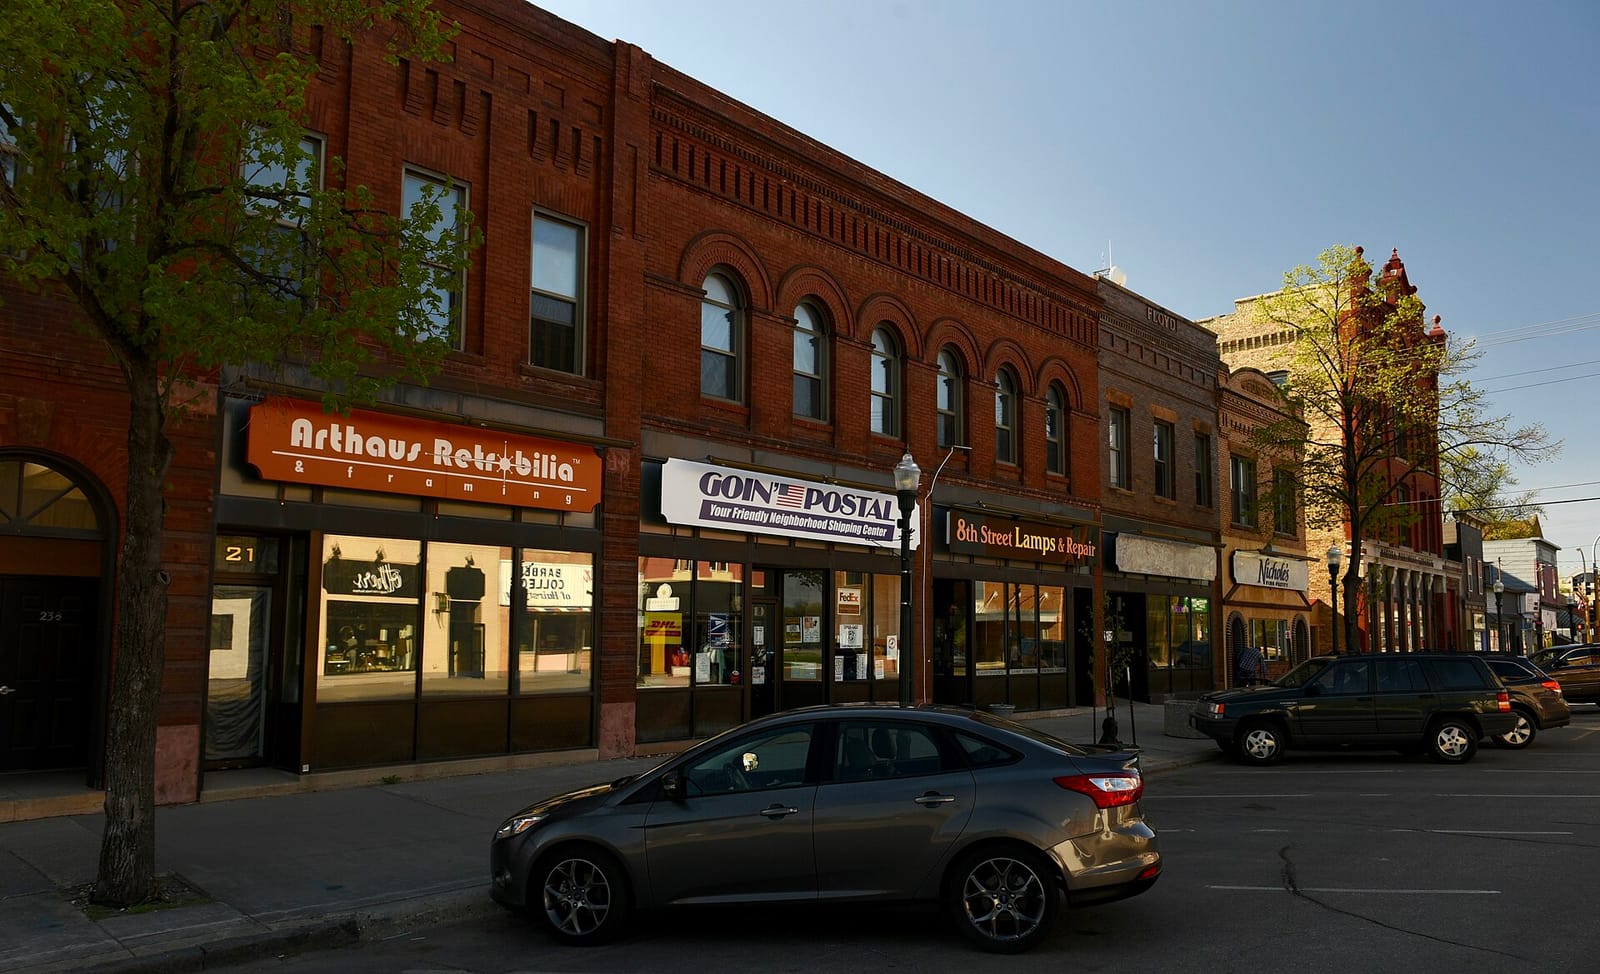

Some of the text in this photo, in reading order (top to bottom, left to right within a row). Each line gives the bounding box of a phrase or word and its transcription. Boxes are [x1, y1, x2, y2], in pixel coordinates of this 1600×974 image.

[1147, 306, 1177, 331] FLOYD
[290, 418, 421, 462] Arthaus
[433, 438, 574, 482] Retrobilia
[295, 460, 305, 473] &
[700, 472, 895, 521] GOIN' POSTAL
[710, 503, 888, 537] Your Friendly Neighborhood Shipping Center
[956, 518, 1097, 559] 8th Street Lamps & Repair
[226, 546, 254, 562] 21
[1258, 558, 1289, 584] Nichole's
[840, 592, 858, 602] FedEx
[651, 620, 675, 629] DHL
